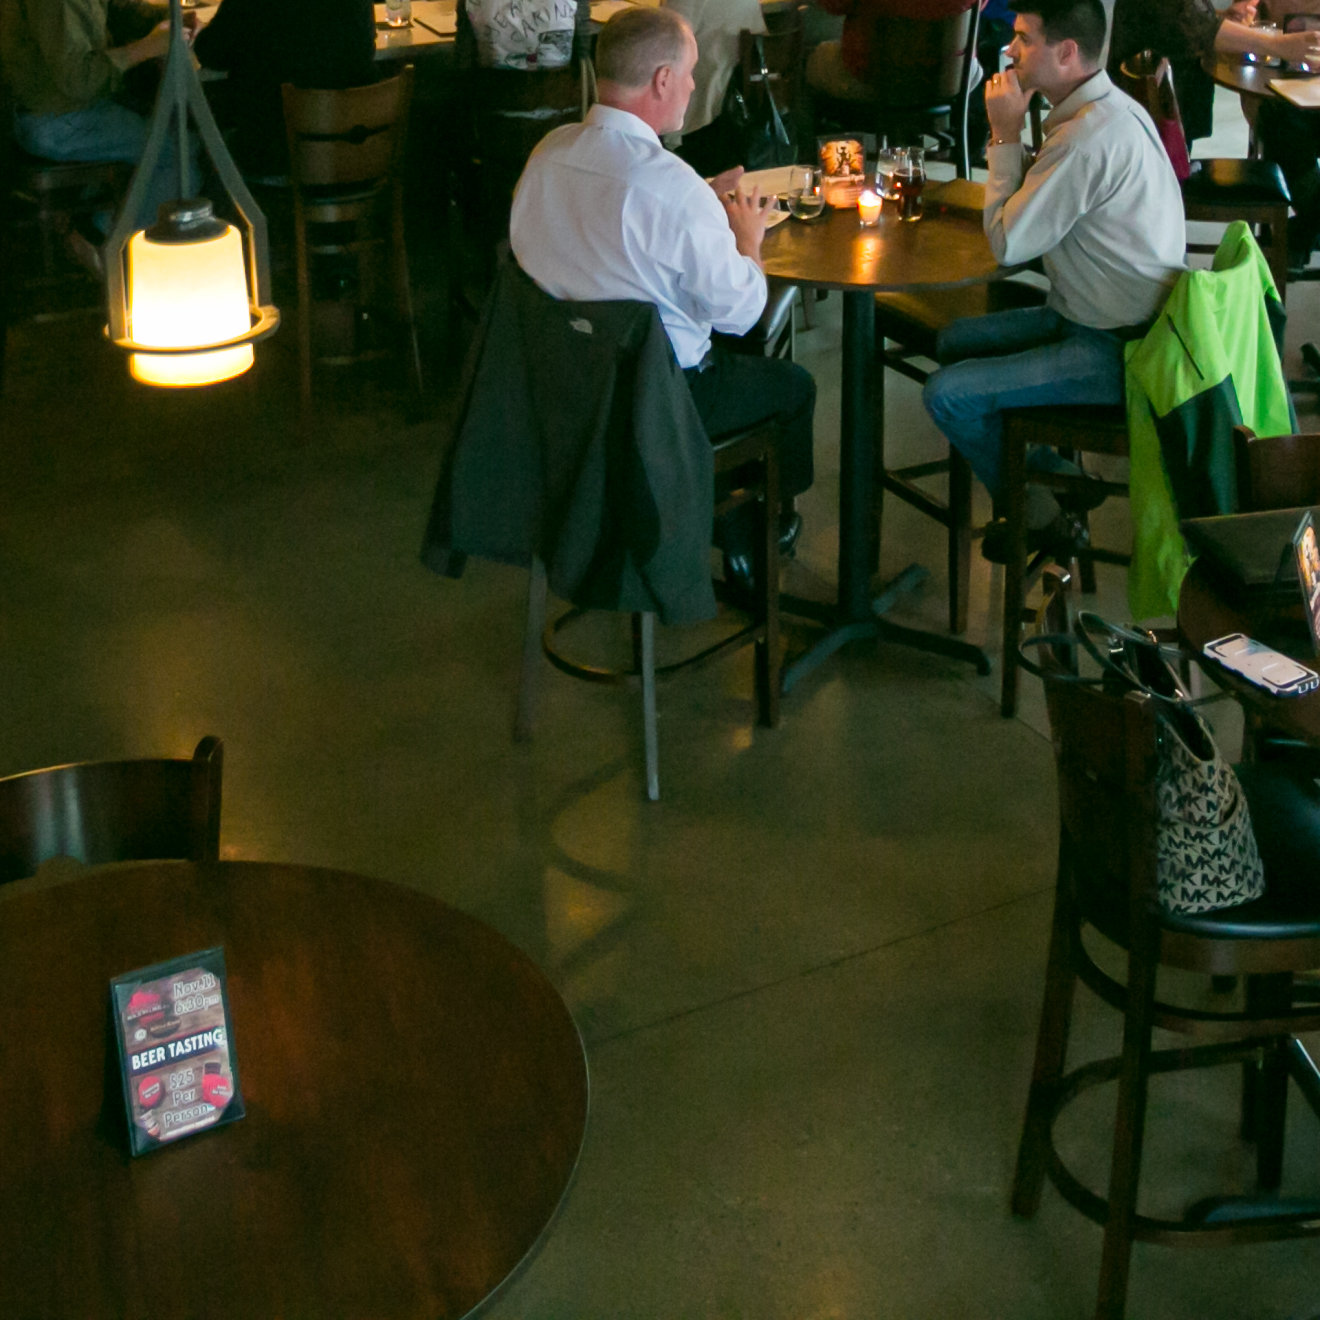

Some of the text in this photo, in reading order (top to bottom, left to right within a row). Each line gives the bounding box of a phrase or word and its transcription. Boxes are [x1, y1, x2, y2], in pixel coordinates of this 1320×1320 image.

[1183, 826, 1216, 846] MK
[1200, 843, 1232, 860] MK
[1184, 853, 1217, 873] MK
[1200, 872, 1232, 890] MK
[1181, 886, 1211, 904] MK
[1216, 886, 1246, 904] MK
[131, 1028, 223, 1070] BEER TASTING
[169, 1067, 195, 1090] $25
[172, 1088, 196, 1107] Per
[163, 1103, 210, 1128] Person
